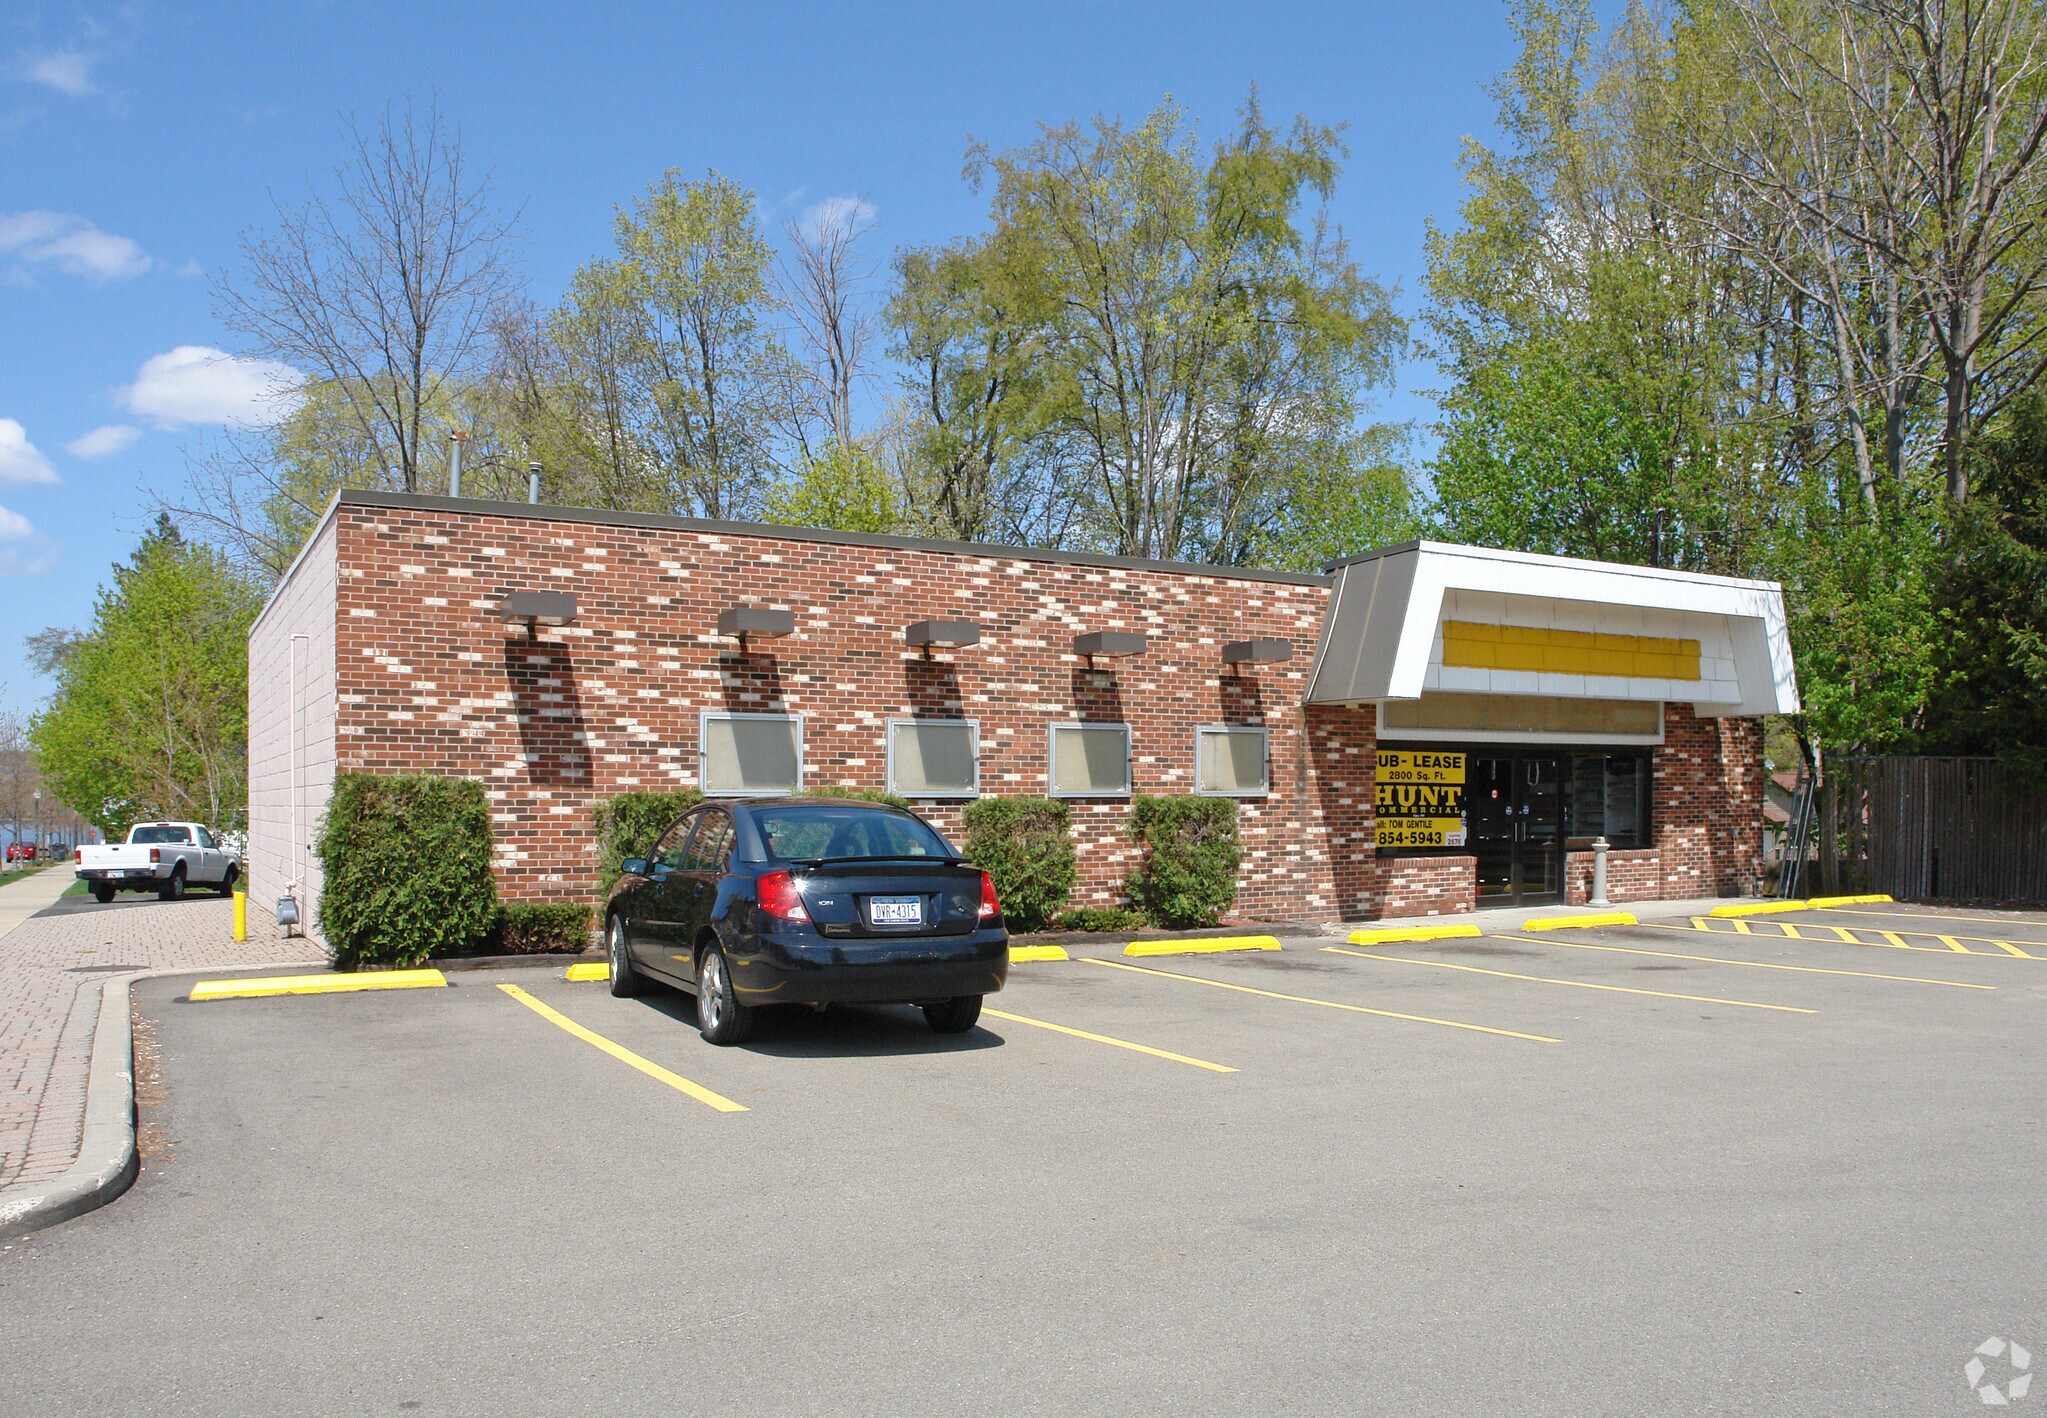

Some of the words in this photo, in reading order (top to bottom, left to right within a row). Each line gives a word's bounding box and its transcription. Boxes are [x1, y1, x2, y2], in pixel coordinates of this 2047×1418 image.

[1376, 754, 1407, 767] UB-
[1413, 755, 1462, 769] LEASE
[1388, 771, 1413, 780] 2800
[1416, 771, 1431, 781] Sq.
[1434, 771, 1446, 780] Ft.
[1376, 785, 1462, 807] HUNT
[1379, 806, 1460, 814] OMMERCIAL
[1388, 820, 1403, 829] TOM
[1406, 820, 1433, 829] GENTILE
